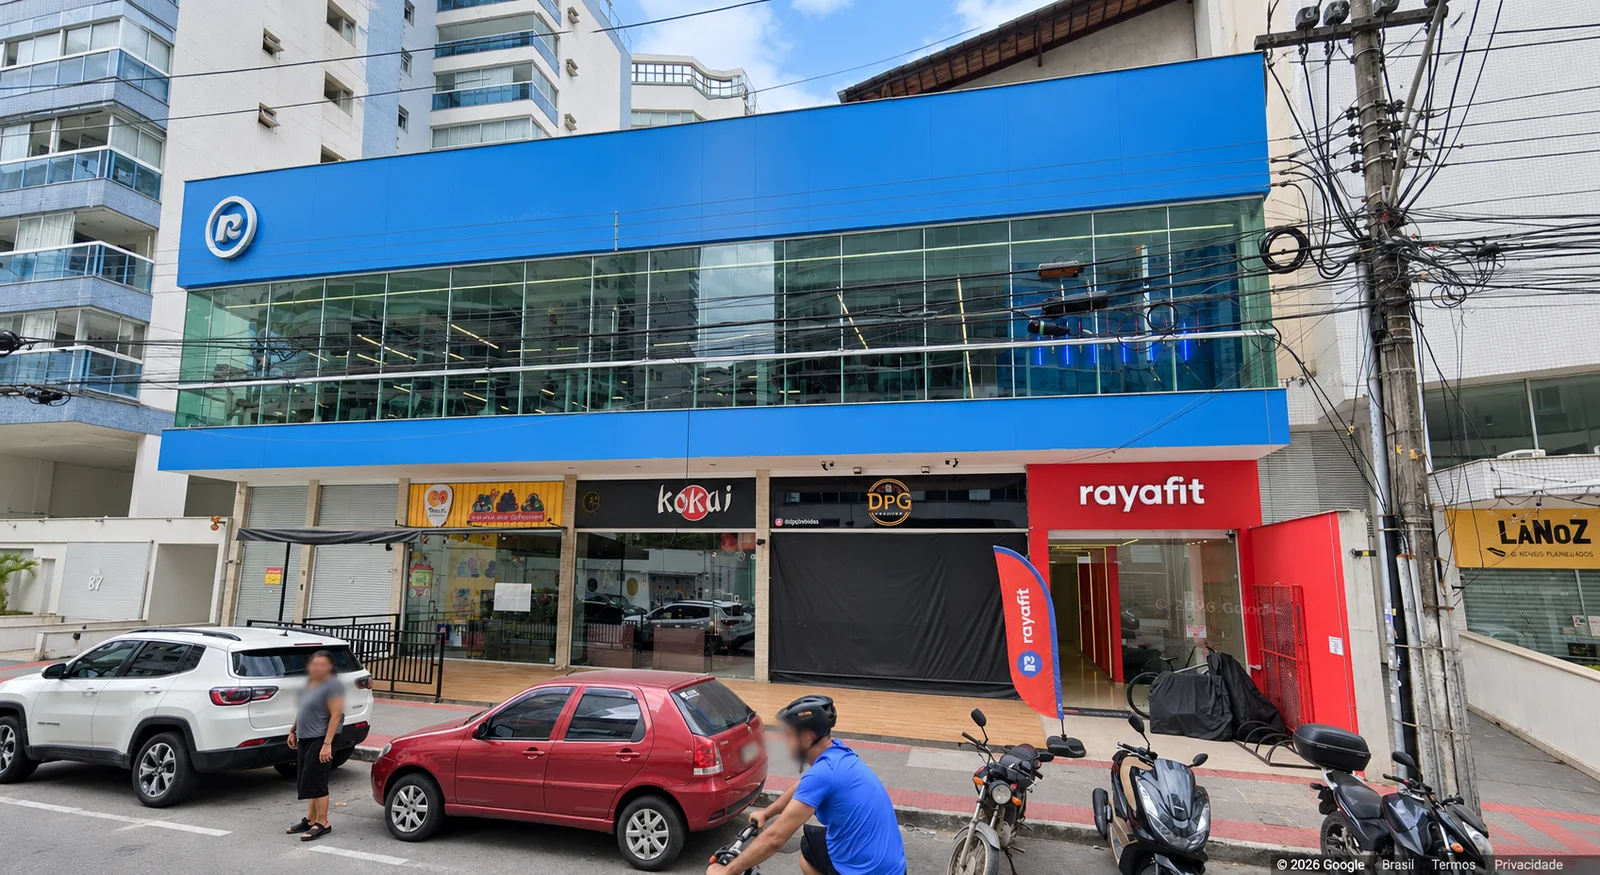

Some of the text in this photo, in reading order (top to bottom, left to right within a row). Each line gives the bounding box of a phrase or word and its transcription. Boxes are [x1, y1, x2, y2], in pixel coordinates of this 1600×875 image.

[867, 492, 912, 511] DPG
[1079, 475, 1206, 513] rayafit
[89, 575, 104, 592] 87
[1016, 588, 1035, 644] rayafit
